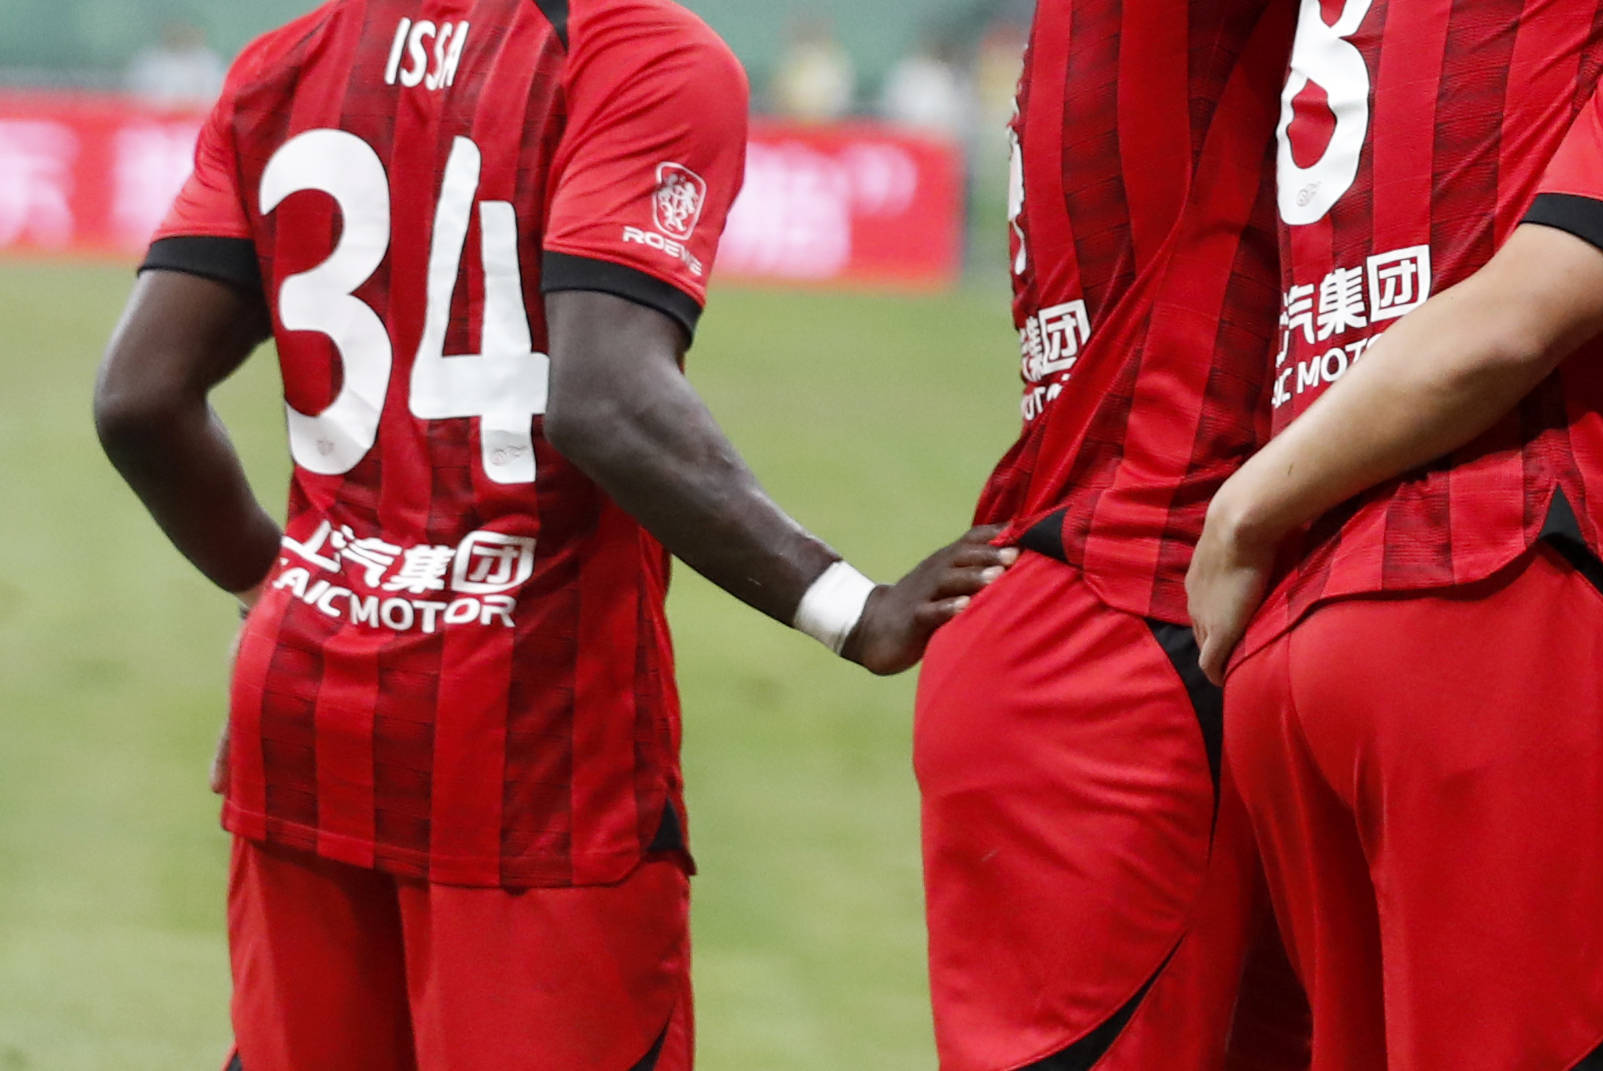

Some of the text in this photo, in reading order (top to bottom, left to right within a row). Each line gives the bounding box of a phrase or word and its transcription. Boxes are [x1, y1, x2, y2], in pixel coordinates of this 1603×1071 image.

[384, 16, 470, 91] ISSA
[258, 128, 550, 484] 34
[1276, 244, 1432, 367] 汽集团
[1296, 332, 1385, 395] MOT
[281, 519, 538, 595] 上汽集团
[271, 557, 517, 634] AIC MOTOR
